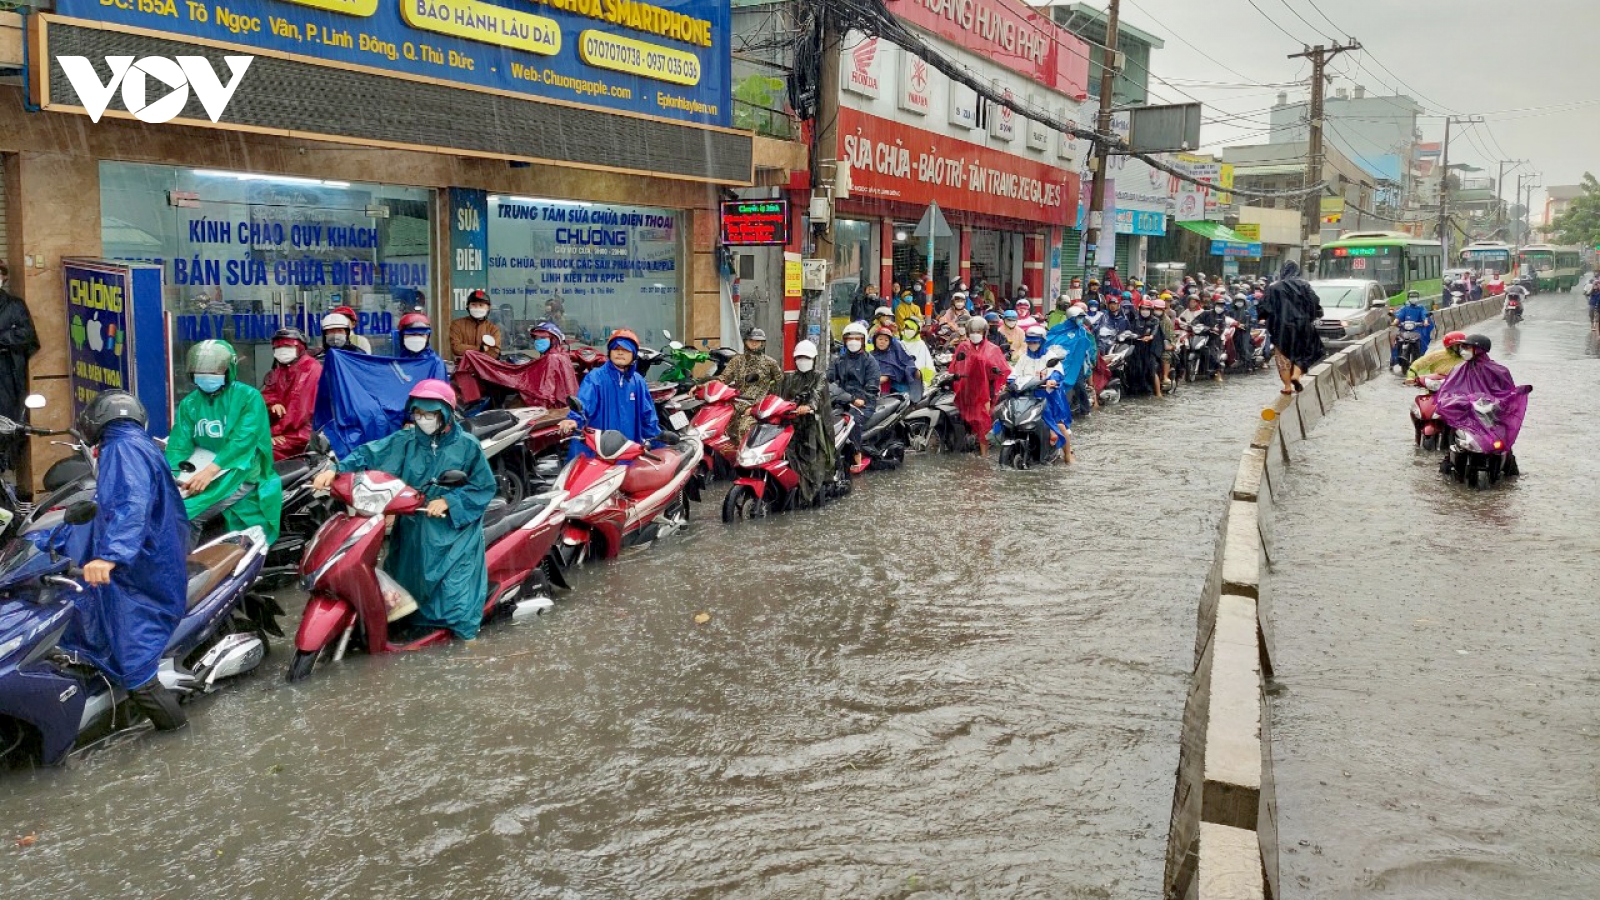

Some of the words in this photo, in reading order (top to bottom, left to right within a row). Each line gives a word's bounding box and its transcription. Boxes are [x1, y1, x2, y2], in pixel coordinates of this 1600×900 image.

[186, 1, 208, 22] Tô
[216, 6, 260, 34] Ngọc
[448, 50, 474, 70] Đức
[455, 6, 497, 33] HÀNH
[502, 18, 529, 40] LÂU
[533, 24, 556, 46] DÀI
[605, 0, 712, 47] SMARTPHONE
[851, 71, 878, 89] HONDA
[844, 127, 873, 171] SỬA
[876, 138, 911, 179] CHỮA
[919, 145, 945, 185] BẢO
[969, 160, 986, 193] TÂN
[988, 168, 1018, 199] TRANG
[458, 201, 480, 231] SỬA
[498, 203, 538, 220] TRUNG
[542, 204, 566, 222] TÂM
[568, 205, 589, 224] SỬA
[589, 207, 618, 225] CHỮA
[620, 209, 643, 228] ĐIỆN
[189, 216, 231, 244] KÍNH
[238, 219, 284, 246] CHÀO
[291, 222, 322, 248] QUÝ
[328, 223, 379, 248] KHÁCH
[174, 253, 220, 286] BÁN
[226, 251, 268, 286] SỬA
[274, 255, 326, 286] CHỮA
[332, 257, 374, 290] ĐIỆN
[380, 262, 427, 290] THOẠI
[456, 243, 482, 276] ĐIỆN
[489, 254, 507, 268] SỬA
[541, 259, 573, 269] UNLOCK
[576, 257, 592, 269] CÁC
[1354, 258, 1365, 269] 89
[541, 273, 561, 283] LINH
[564, 270, 582, 285] KIỆN
[600, 273, 625, 283] APPLE
[177, 311, 226, 340] MÁY
[233, 310, 280, 338] TÍNH
